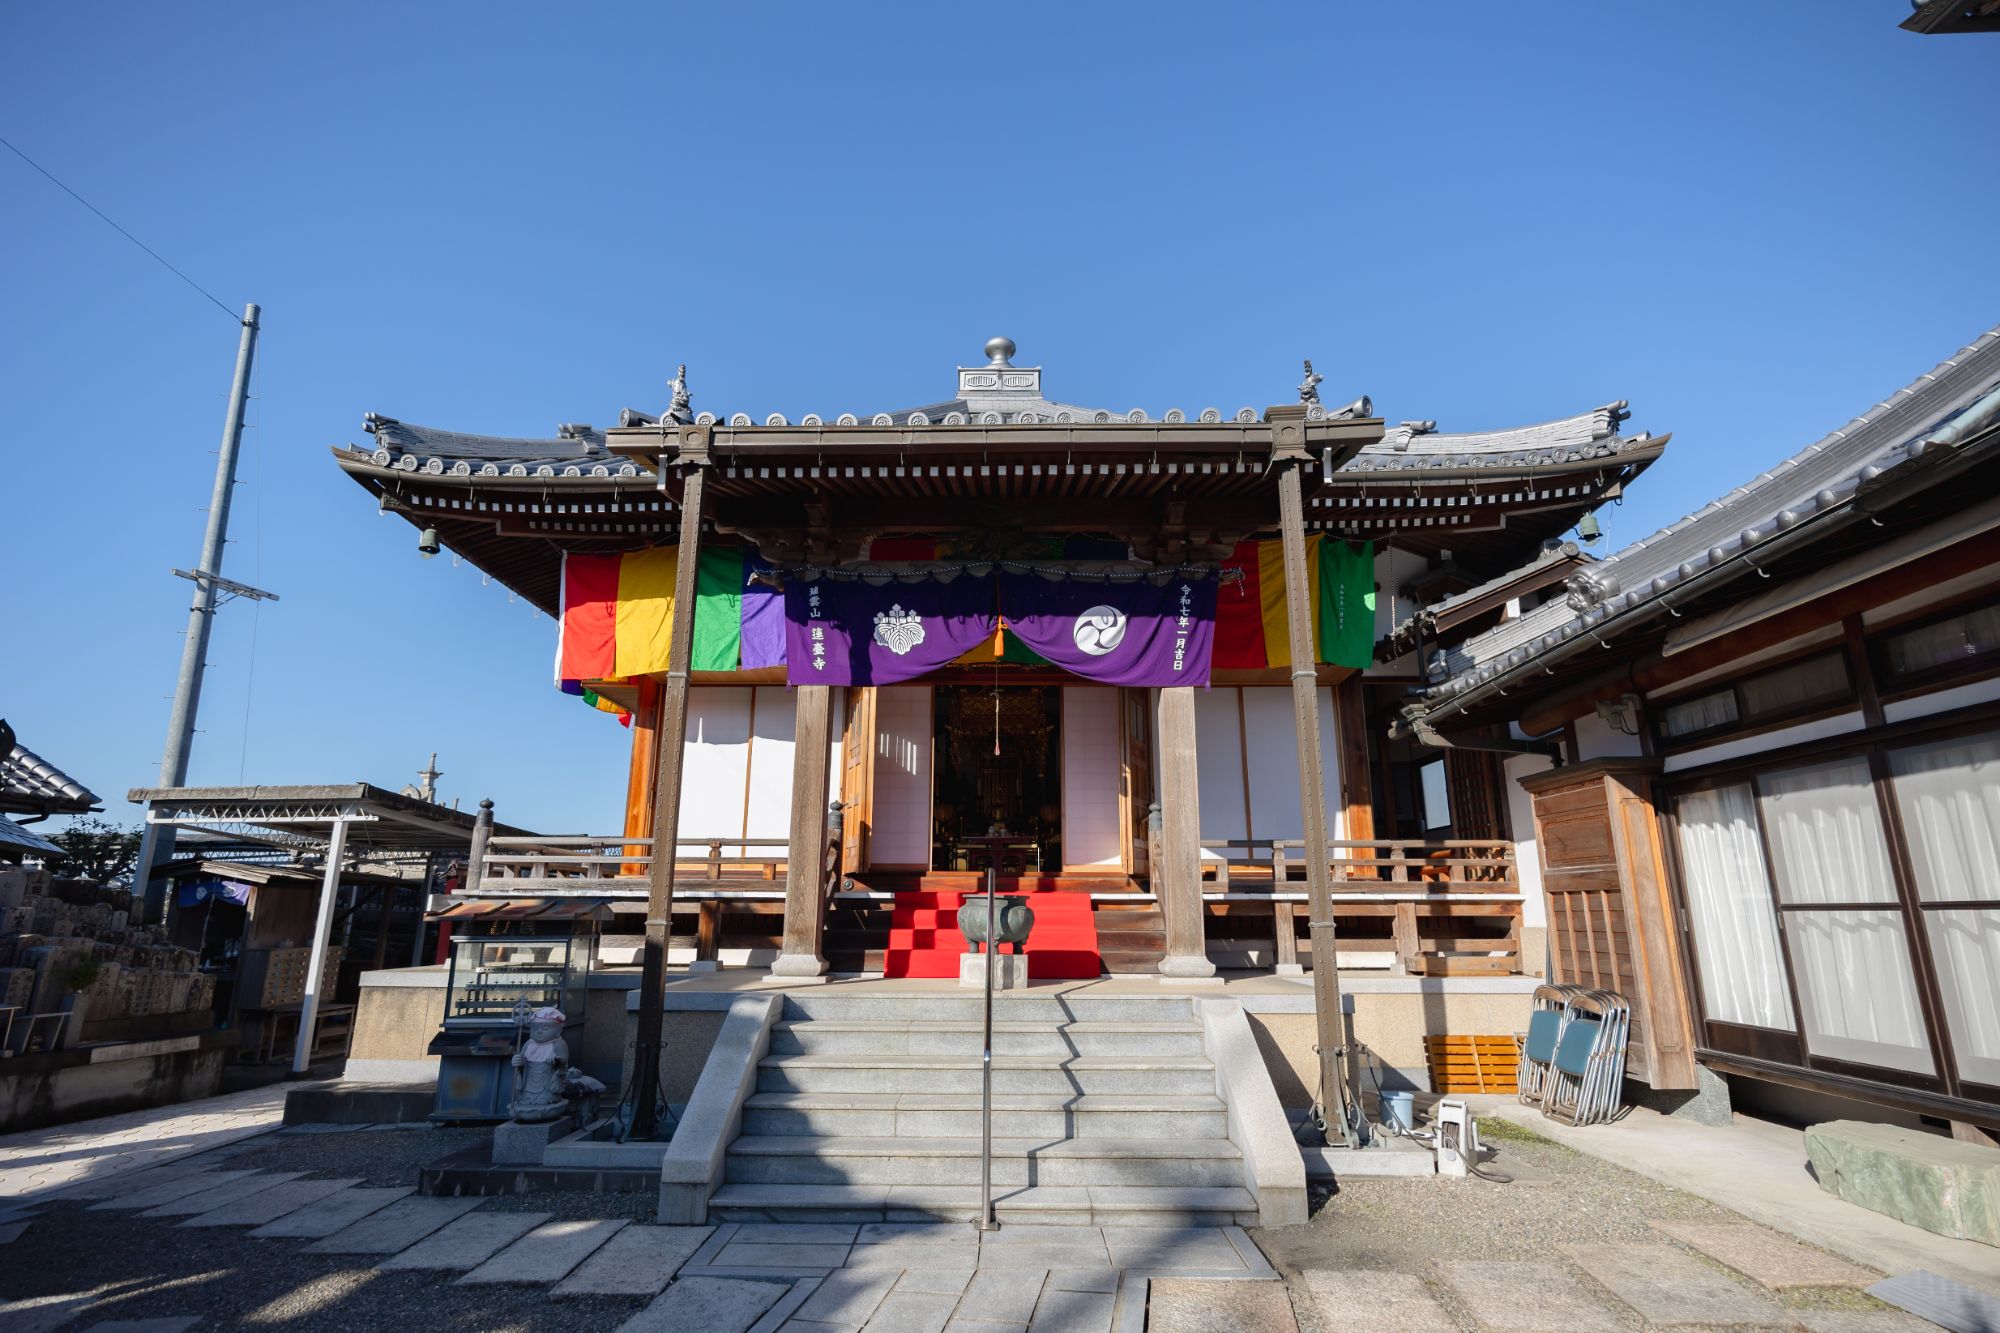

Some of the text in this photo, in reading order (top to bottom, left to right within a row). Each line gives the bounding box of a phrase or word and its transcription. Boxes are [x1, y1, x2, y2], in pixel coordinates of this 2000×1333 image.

[1173, 584, 1192, 671] 令和七年一月吉日
